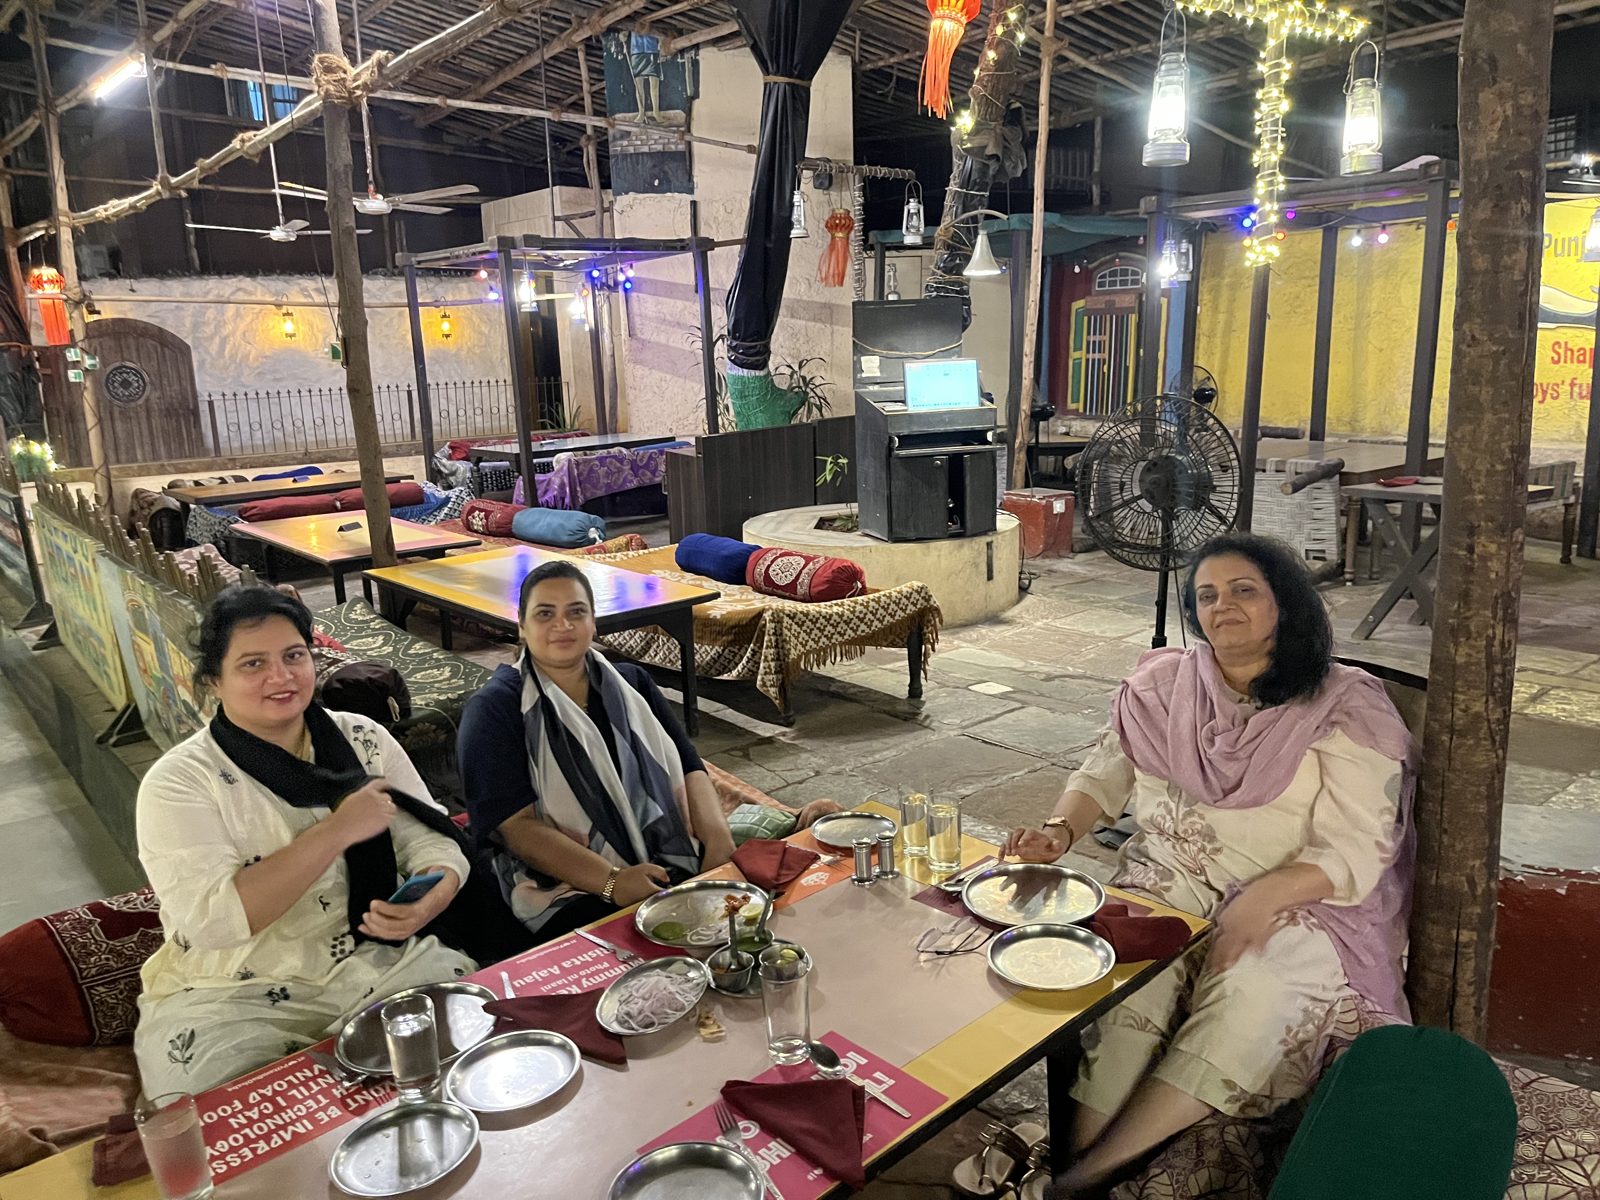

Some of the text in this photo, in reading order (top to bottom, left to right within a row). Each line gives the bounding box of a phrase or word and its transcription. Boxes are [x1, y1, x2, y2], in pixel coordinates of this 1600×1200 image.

[512, 965, 561, 988] Aajau
[579, 961, 610, 977] Photo
[199, 1099, 243, 1127] FOO
[276, 1096, 287, 1107] I
[228, 1102, 274, 1129] CAN
[315, 1106, 343, 1125] BE
[205, 1095, 330, 1160] TECHNOLOGY
